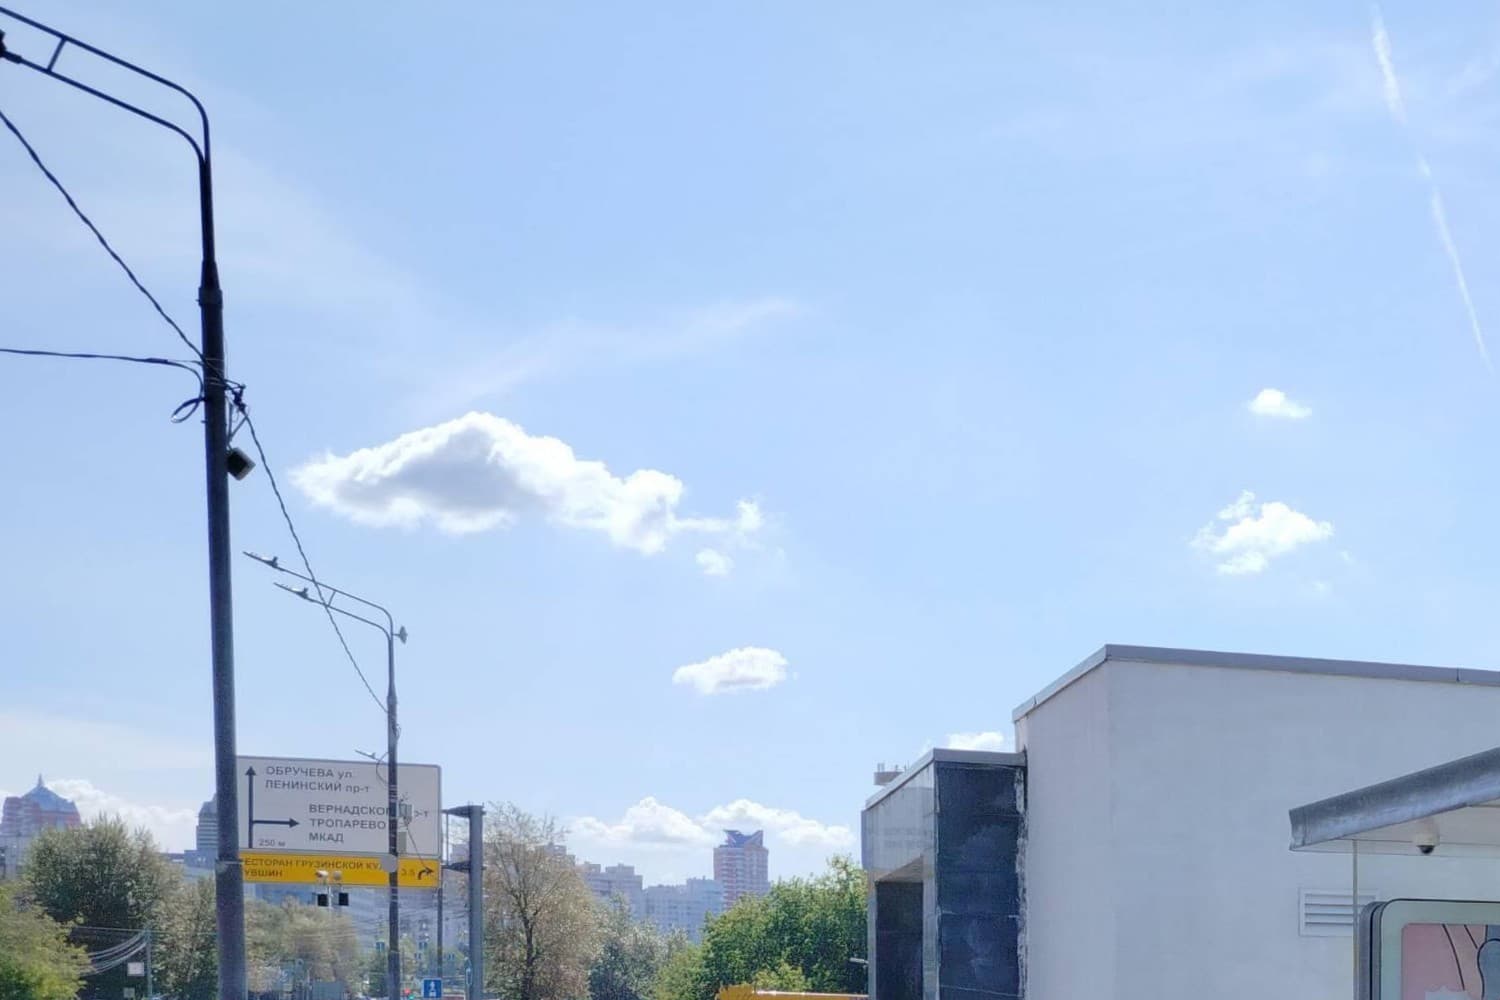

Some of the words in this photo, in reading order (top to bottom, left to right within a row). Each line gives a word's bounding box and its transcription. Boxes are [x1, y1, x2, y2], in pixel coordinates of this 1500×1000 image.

[266, 766, 334, 778] ОБРУЧЕВА
[265, 779, 342, 793] ЛЕНИНСКИЙ
[309, 818, 386, 830] ТРОПАРЕВО
[259, 838, 275, 847] 250
[309, 832, 344, 843] МКАД
[242, 857, 293, 867] ЕСТОРАН
[243, 868, 283, 878] УВШИН
